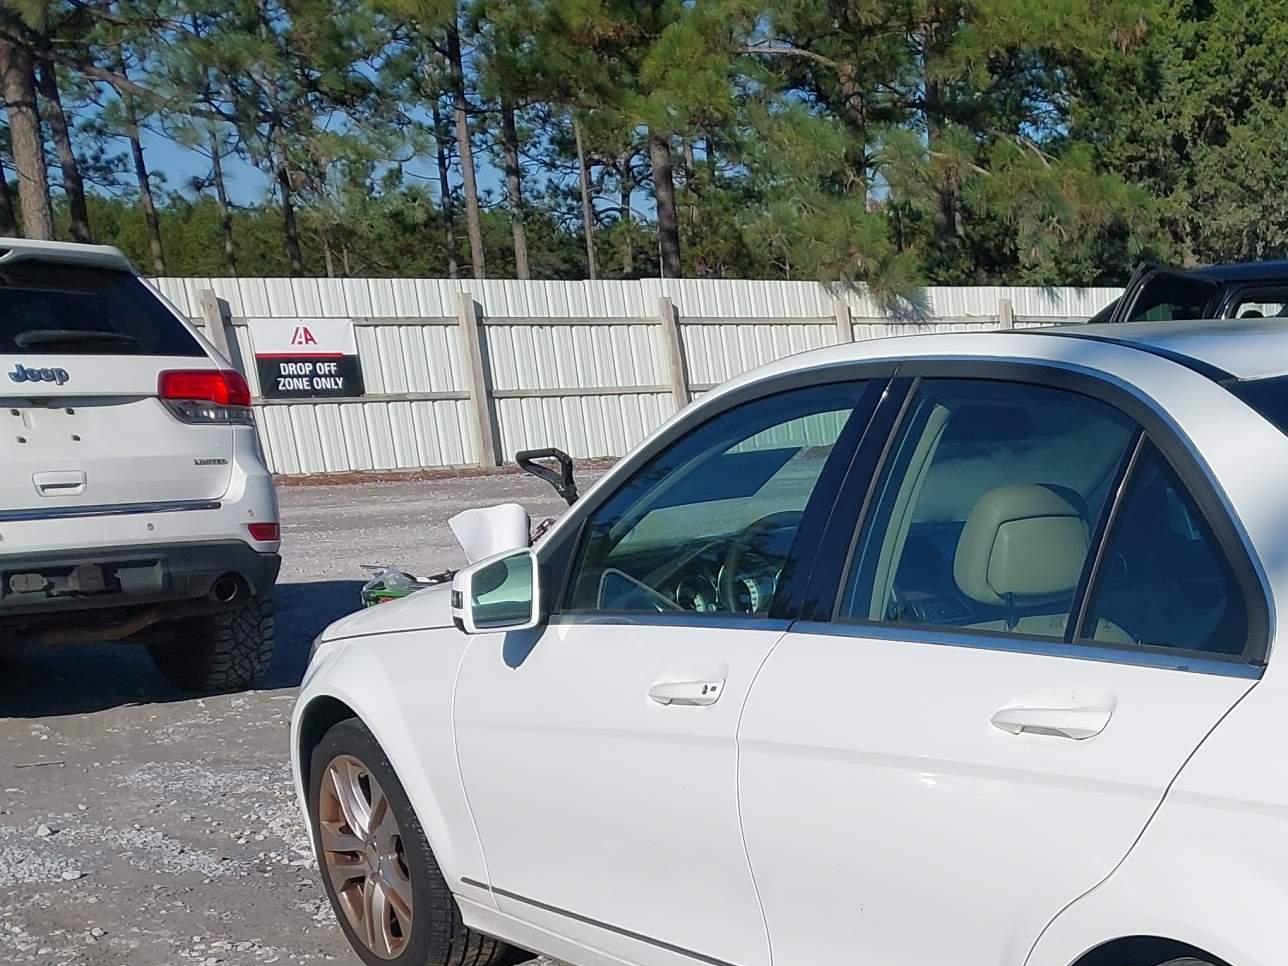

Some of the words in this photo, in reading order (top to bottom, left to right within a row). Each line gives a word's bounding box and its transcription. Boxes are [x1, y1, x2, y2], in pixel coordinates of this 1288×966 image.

[8, 364, 70, 386] Jeep
[279, 362, 313, 375] DROP
[315, 362, 337, 374] OFF
[277, 377, 311, 390] ZONE
[313, 377, 343, 389] ONLY
